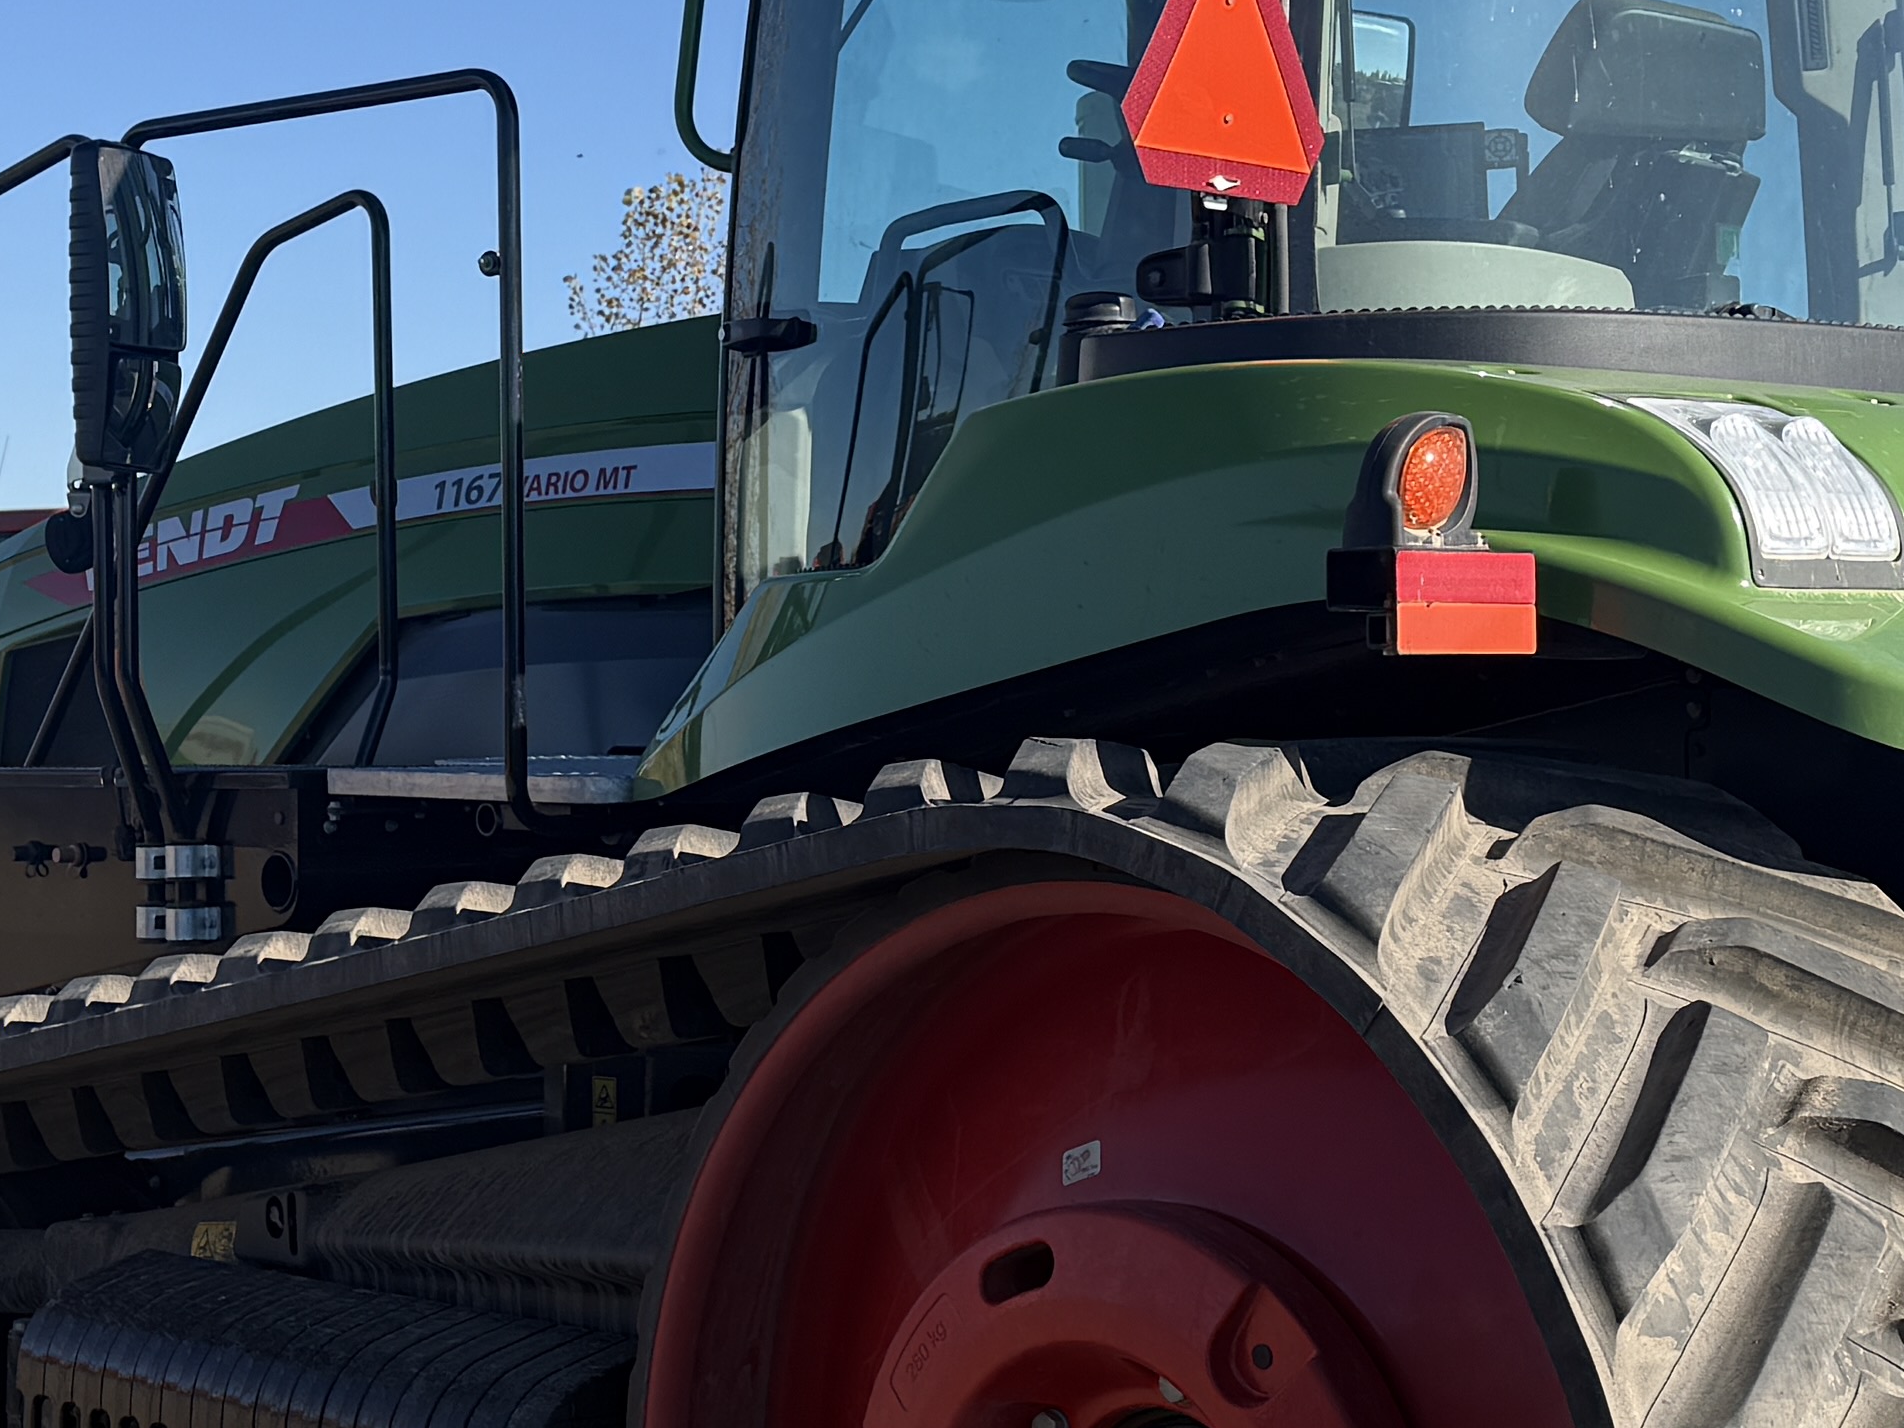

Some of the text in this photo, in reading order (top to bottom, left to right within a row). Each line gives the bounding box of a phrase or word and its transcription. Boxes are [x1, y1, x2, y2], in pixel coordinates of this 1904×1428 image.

[434, 464, 638, 511] 1167 ARIO MT
